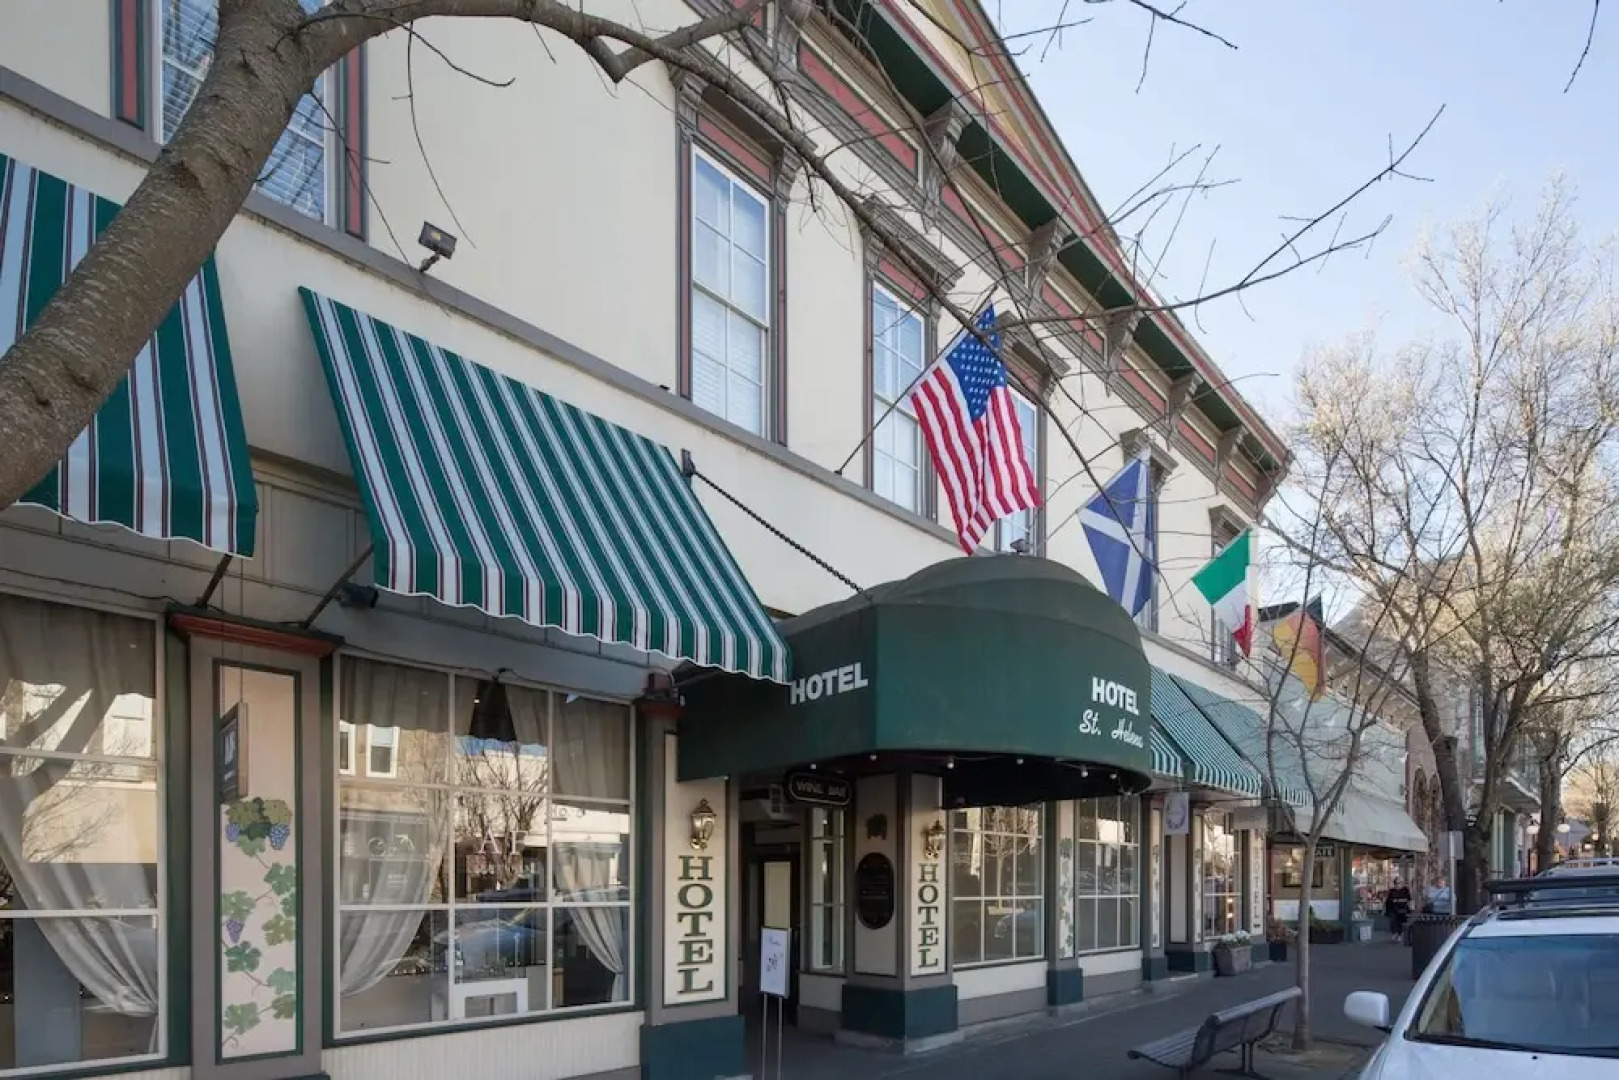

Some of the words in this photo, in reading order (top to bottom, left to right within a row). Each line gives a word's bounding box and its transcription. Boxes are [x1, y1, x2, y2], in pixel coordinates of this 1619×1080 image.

[790, 661, 869, 705] HOTEL
[1092, 676, 1140, 716] HOTEL
[1079, 708, 1102, 736] St.
[677, 855, 713, 995] HOTEL
[918, 862, 939, 969] HOTEL
